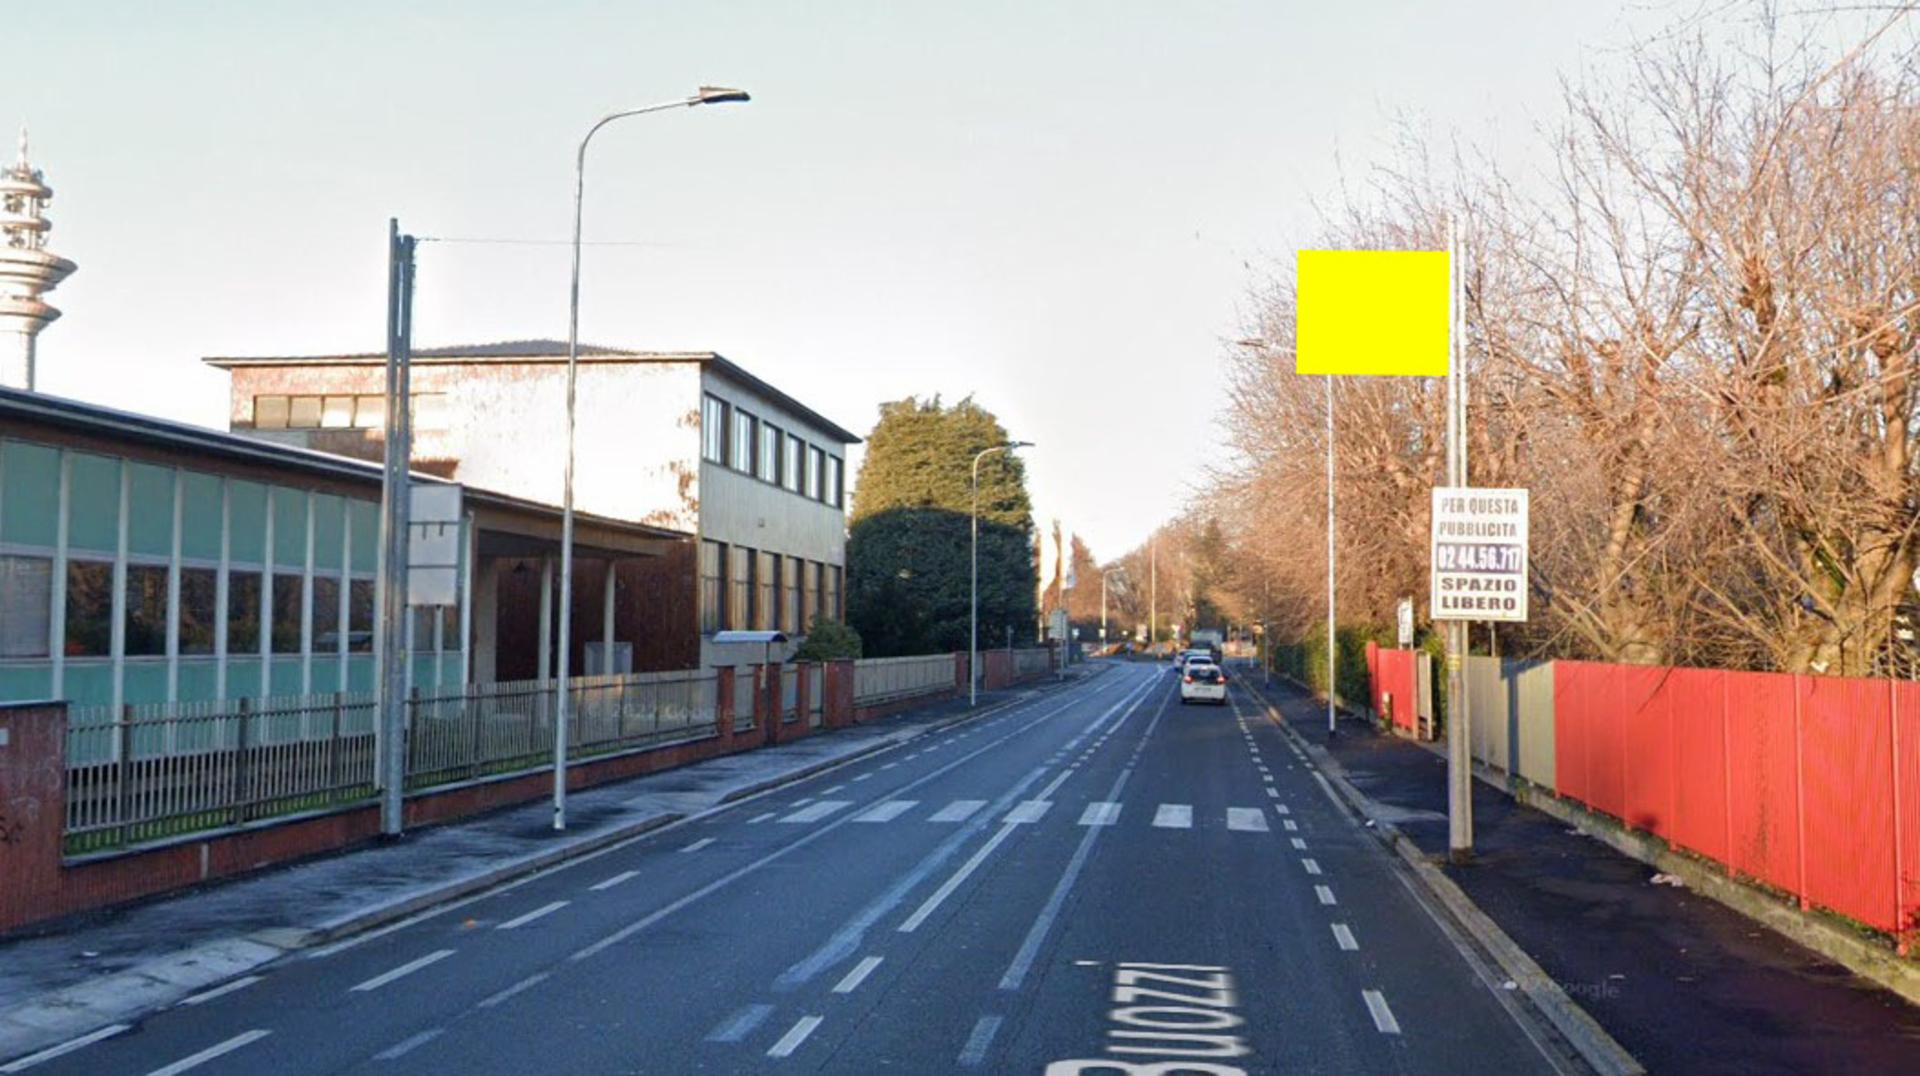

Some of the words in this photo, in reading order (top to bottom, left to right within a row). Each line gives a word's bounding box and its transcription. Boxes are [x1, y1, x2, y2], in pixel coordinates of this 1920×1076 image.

[1442, 498, 1465, 514] PER
[1469, 498, 1518, 514] QUESTA
[1437, 545, 1456, 570] 02
[1442, 578, 1517, 592] SPAZIO
[1442, 597, 1516, 611] LIBERO
